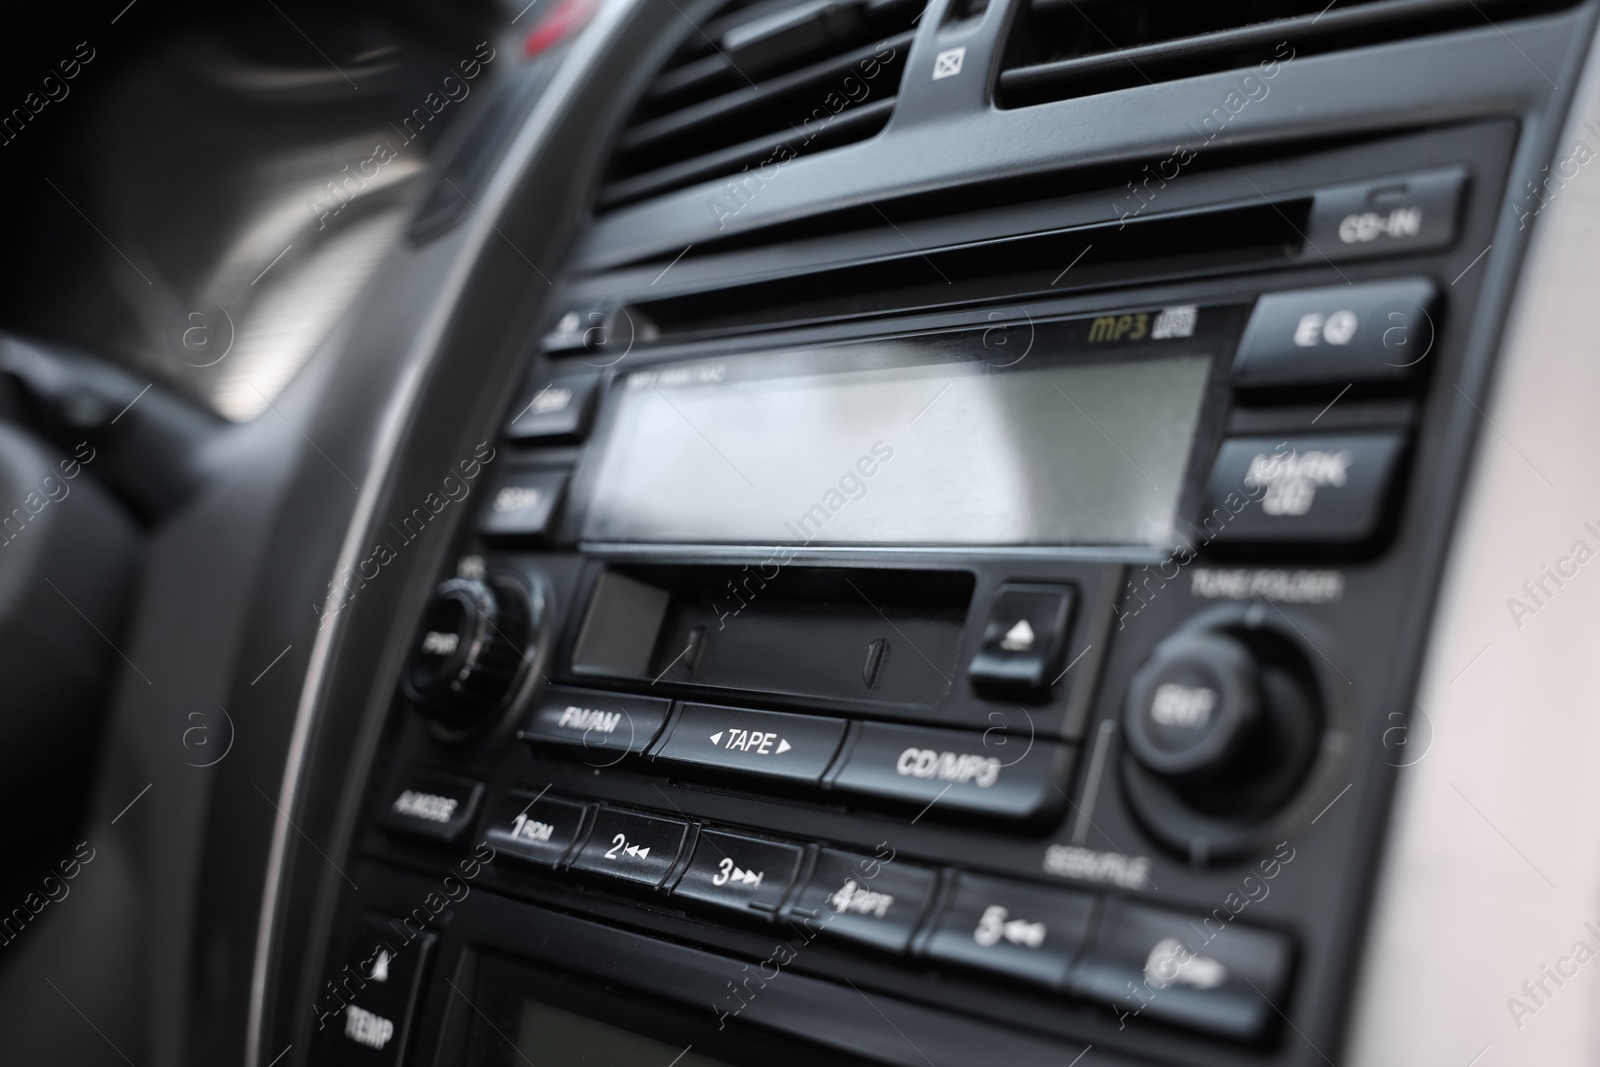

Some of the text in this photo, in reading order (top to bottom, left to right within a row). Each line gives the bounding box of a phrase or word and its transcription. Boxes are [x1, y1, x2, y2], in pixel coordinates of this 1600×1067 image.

[1338, 206, 1422, 243] CD-IN
[1088, 313, 1150, 343] MP3
[558, 705, 622, 733] FM/AM
[725, 728, 778, 754] TAPE
[896, 747, 1002, 788] CD/MP3
[604, 833, 626, 860] 2
[713, 857, 735, 886] 3
[974, 904, 1009, 947] 5
[345, 1004, 394, 1051] TEMP
